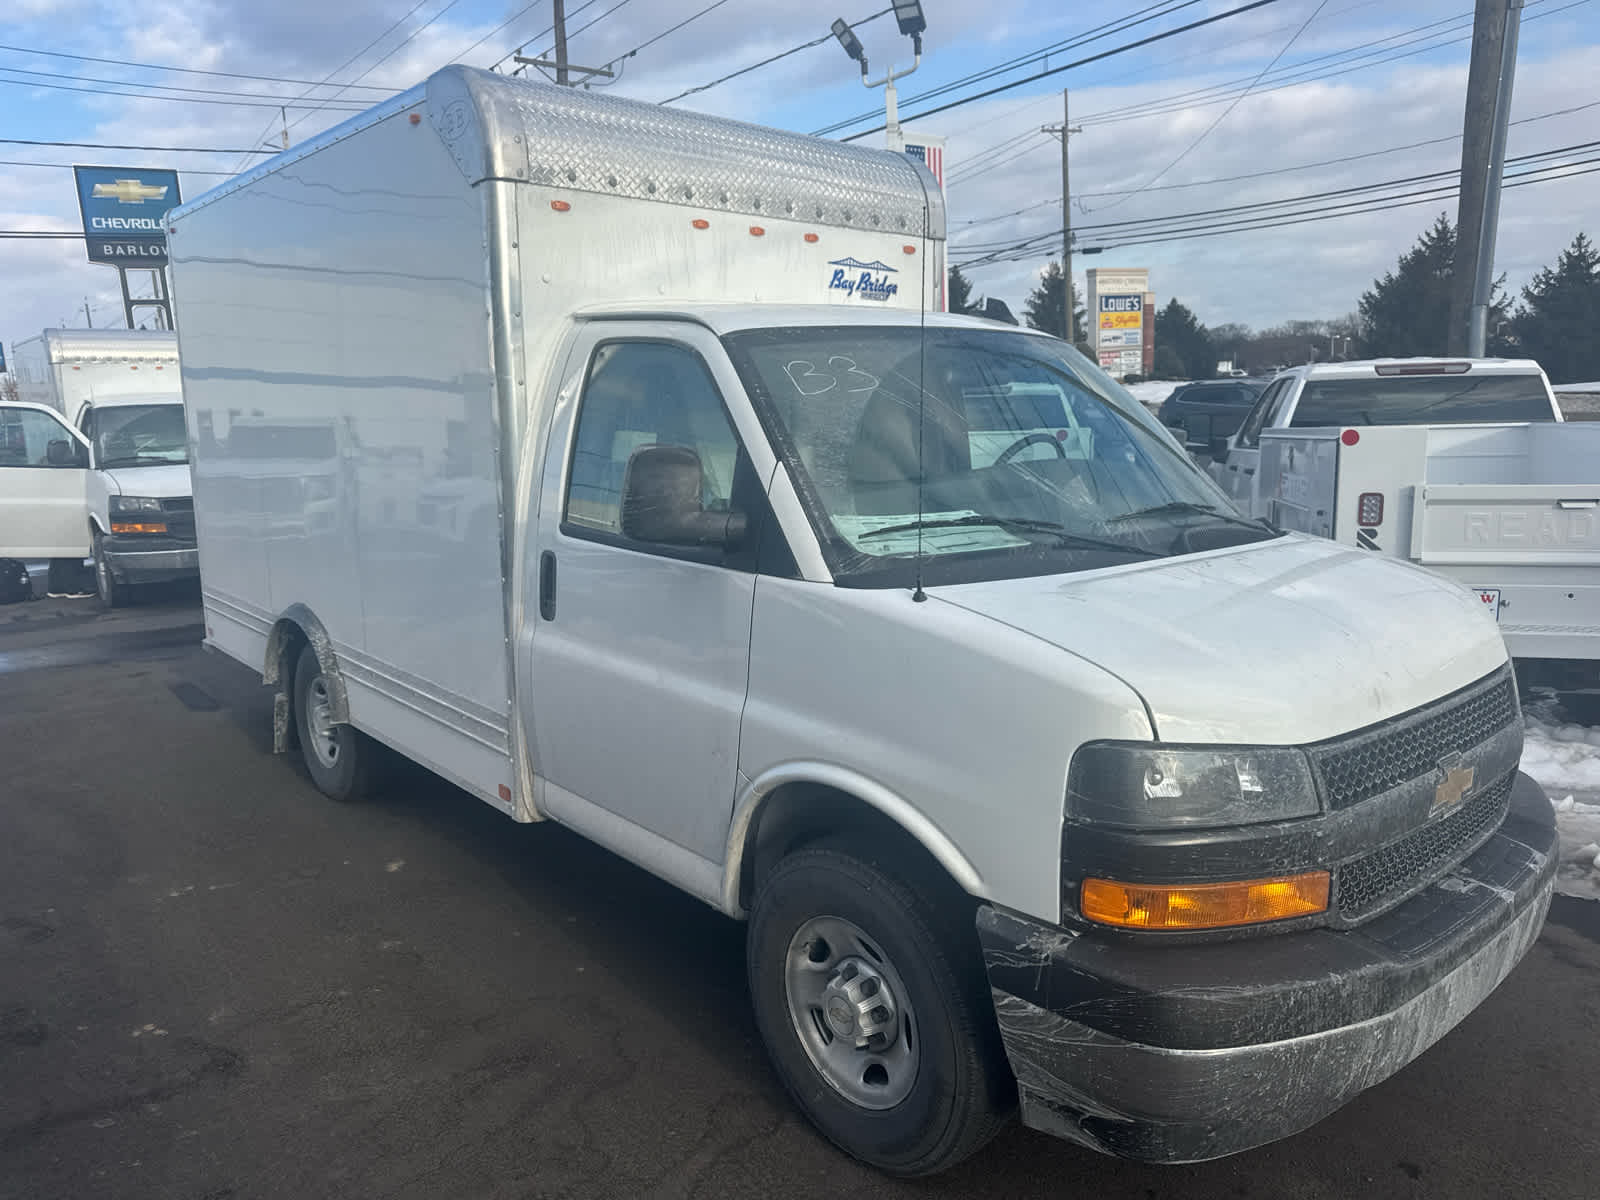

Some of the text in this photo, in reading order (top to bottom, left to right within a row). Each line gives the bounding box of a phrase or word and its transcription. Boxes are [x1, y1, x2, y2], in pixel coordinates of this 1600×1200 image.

[829, 268, 898, 300] Bay Bridge
[1101, 296, 1140, 311] LOWE'S
[783, 355, 879, 395] B3
